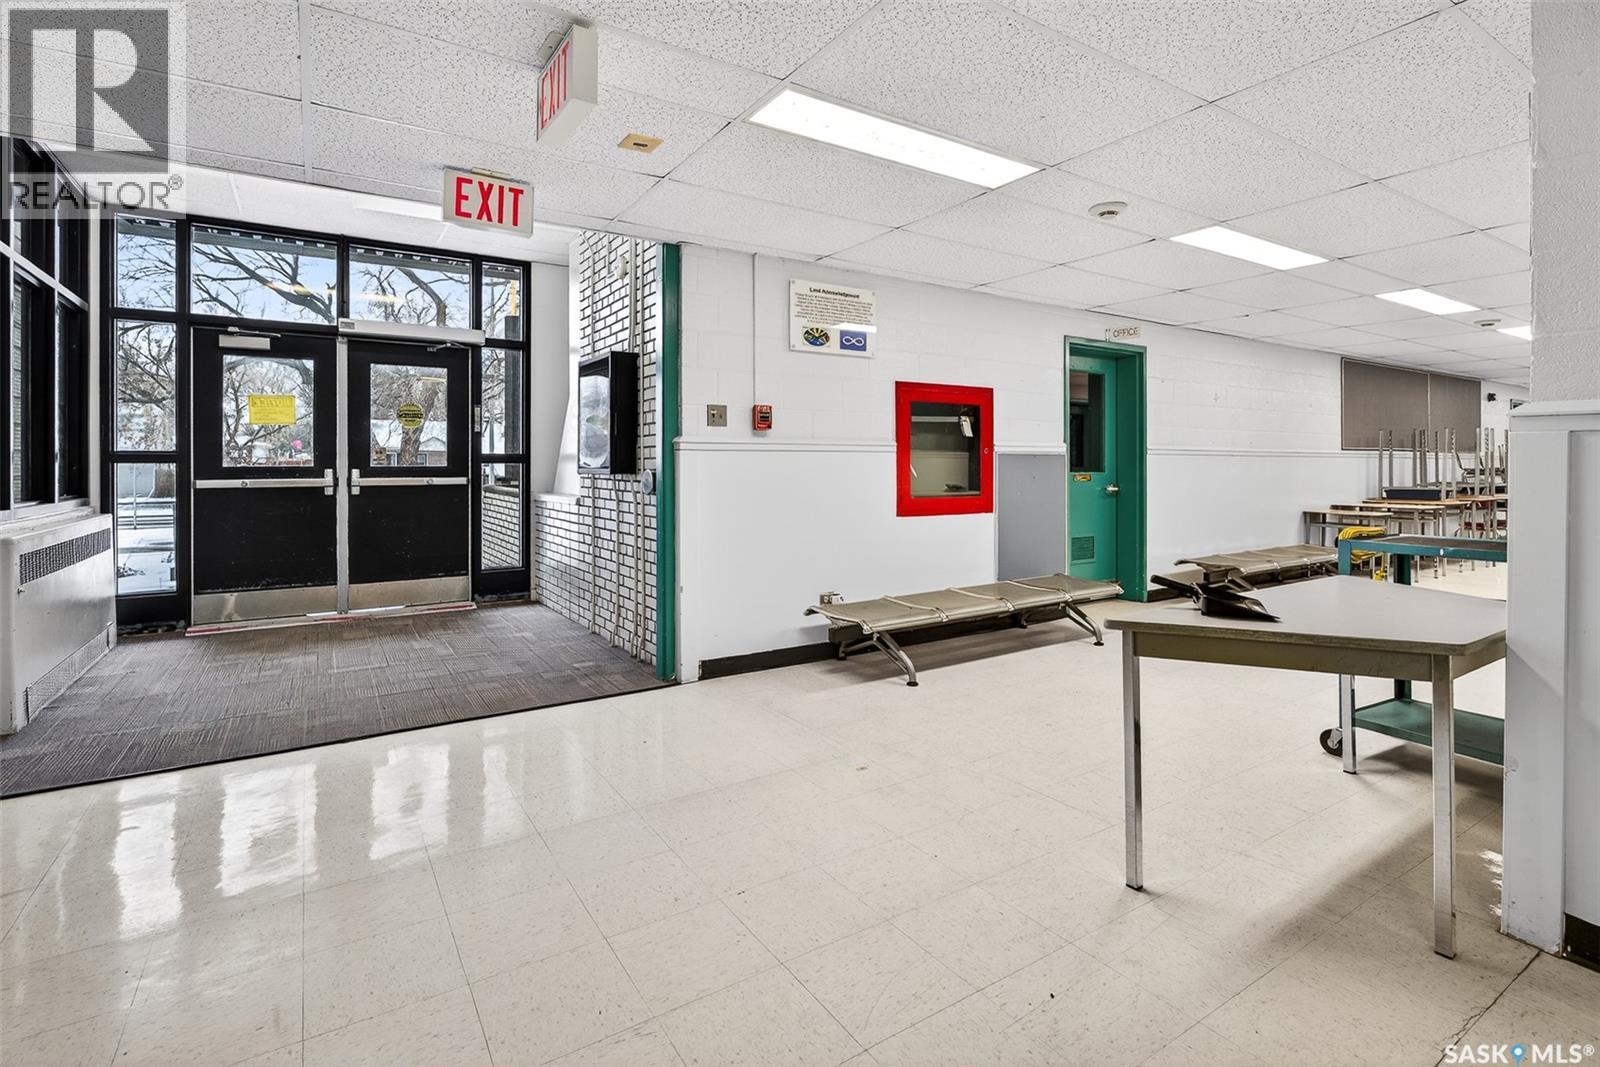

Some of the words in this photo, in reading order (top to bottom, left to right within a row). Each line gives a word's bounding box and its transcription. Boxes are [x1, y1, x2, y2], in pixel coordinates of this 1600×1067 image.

[540, 41, 570, 130] EXIT
[454, 176, 525, 227] EXIT
[1112, 327, 1139, 337] OFFICE
